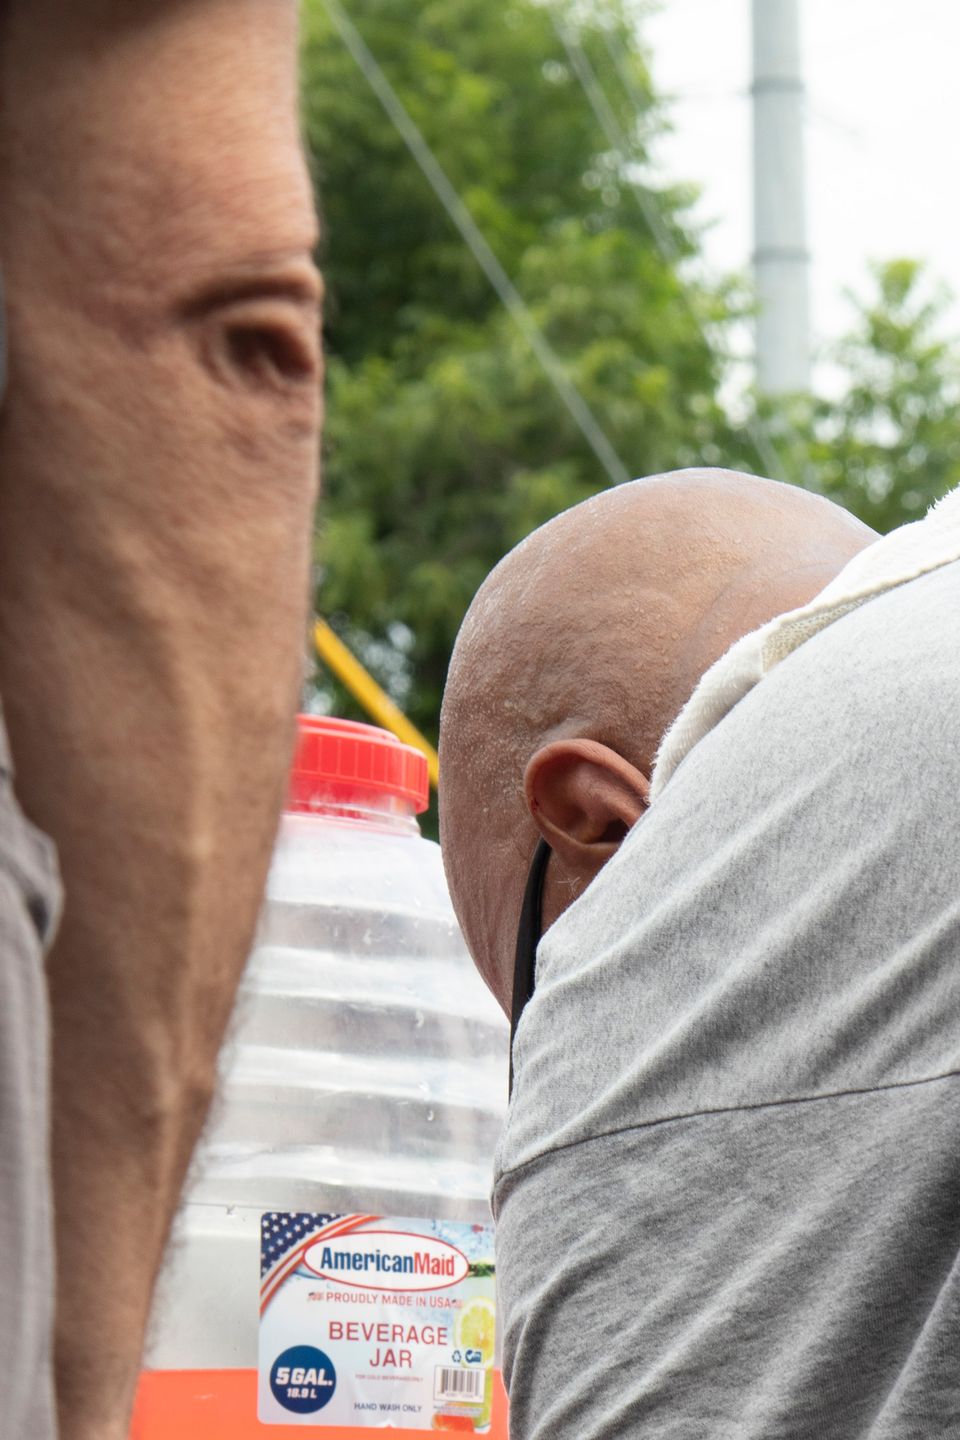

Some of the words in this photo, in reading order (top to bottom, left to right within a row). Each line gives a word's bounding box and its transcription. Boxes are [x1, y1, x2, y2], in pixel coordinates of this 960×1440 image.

[320, 1247, 455, 1277] AmericanMaid
[326, 1291, 378, 1305] PROUDLY
[381, 1295, 413, 1307] MADE
[415, 1297, 426, 1308] IN
[429, 1297, 452, 1309] USA
[329, 1321, 448, 1345] BEVERAGE
[370, 1348, 412, 1369] JAR
[354, 1402, 377, 1411] HAND
[379, 1402, 401, 1412] WASH
[402, 1403, 422, 1413] ONLY
